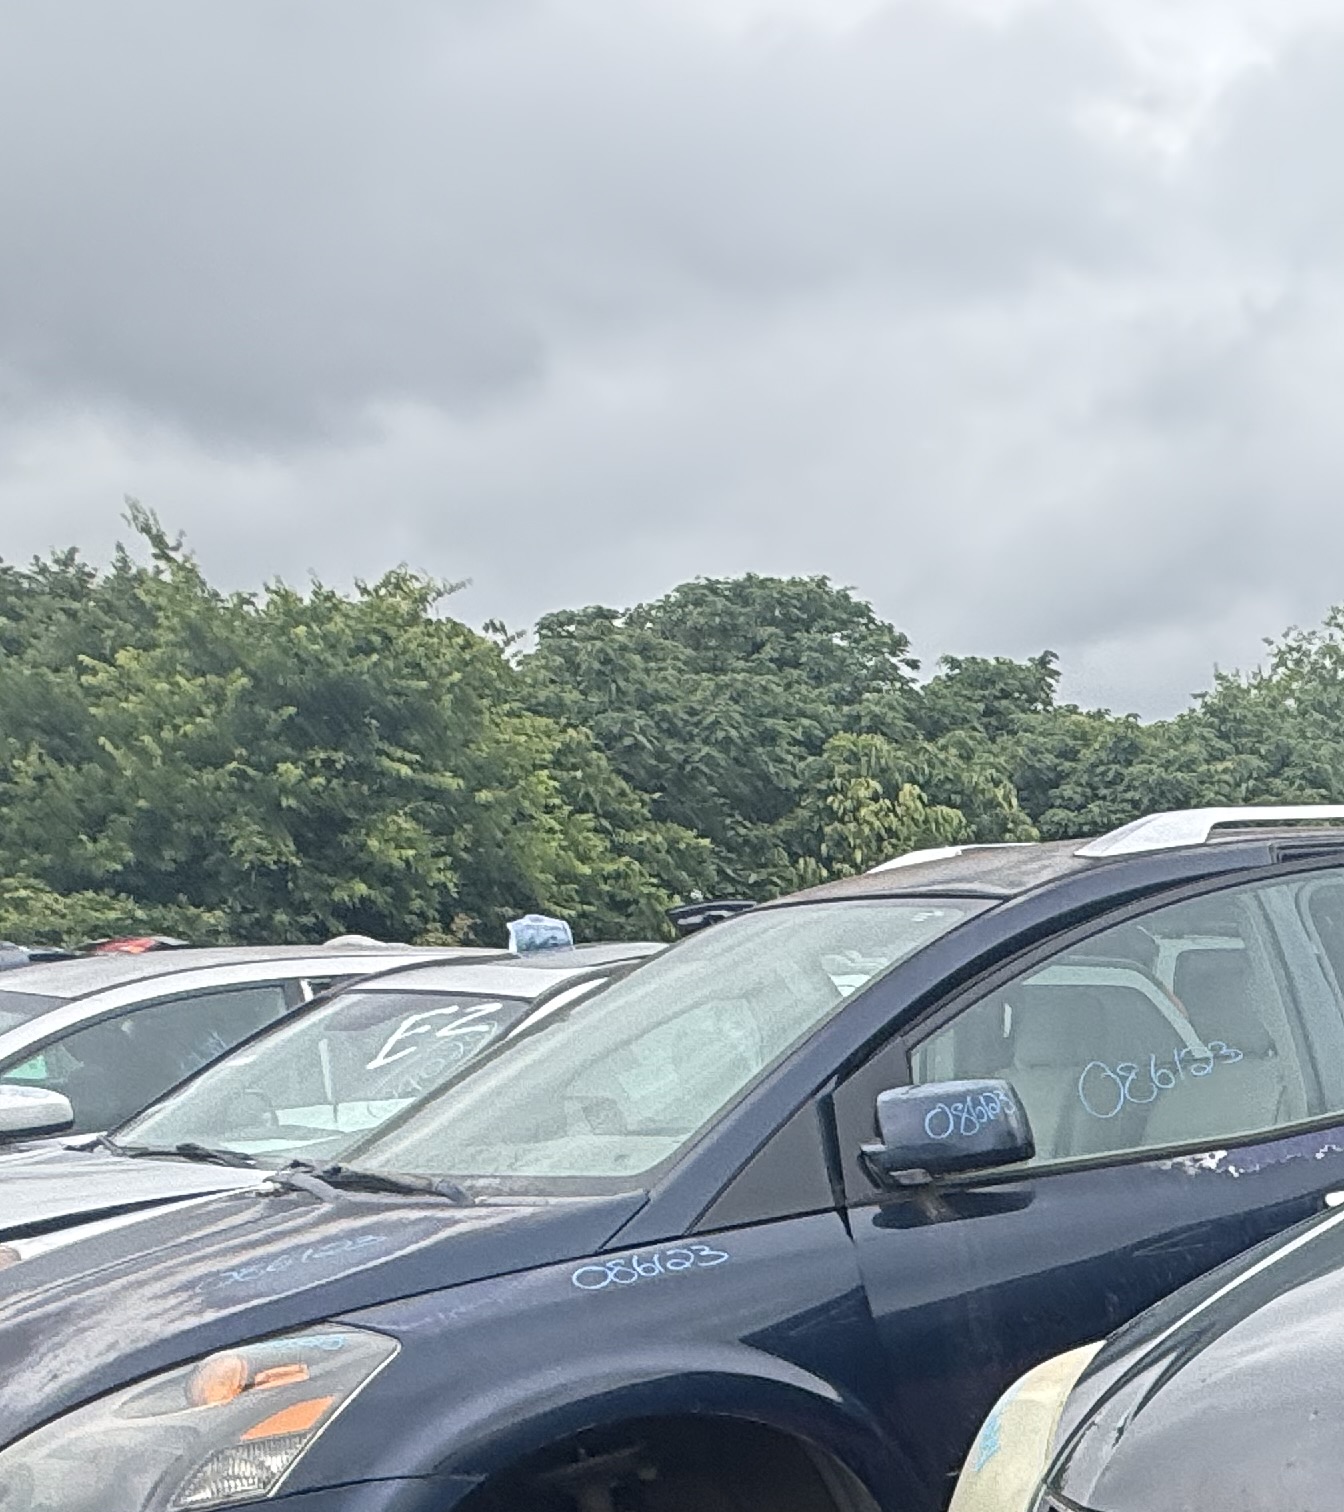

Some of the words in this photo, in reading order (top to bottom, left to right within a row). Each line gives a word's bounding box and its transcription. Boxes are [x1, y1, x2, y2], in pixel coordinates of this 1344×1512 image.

[1079, 1042, 1244, 1118] 086123
[924, 1091, 1016, 1139] 086123
[572, 1245, 729, 1289] 086123
